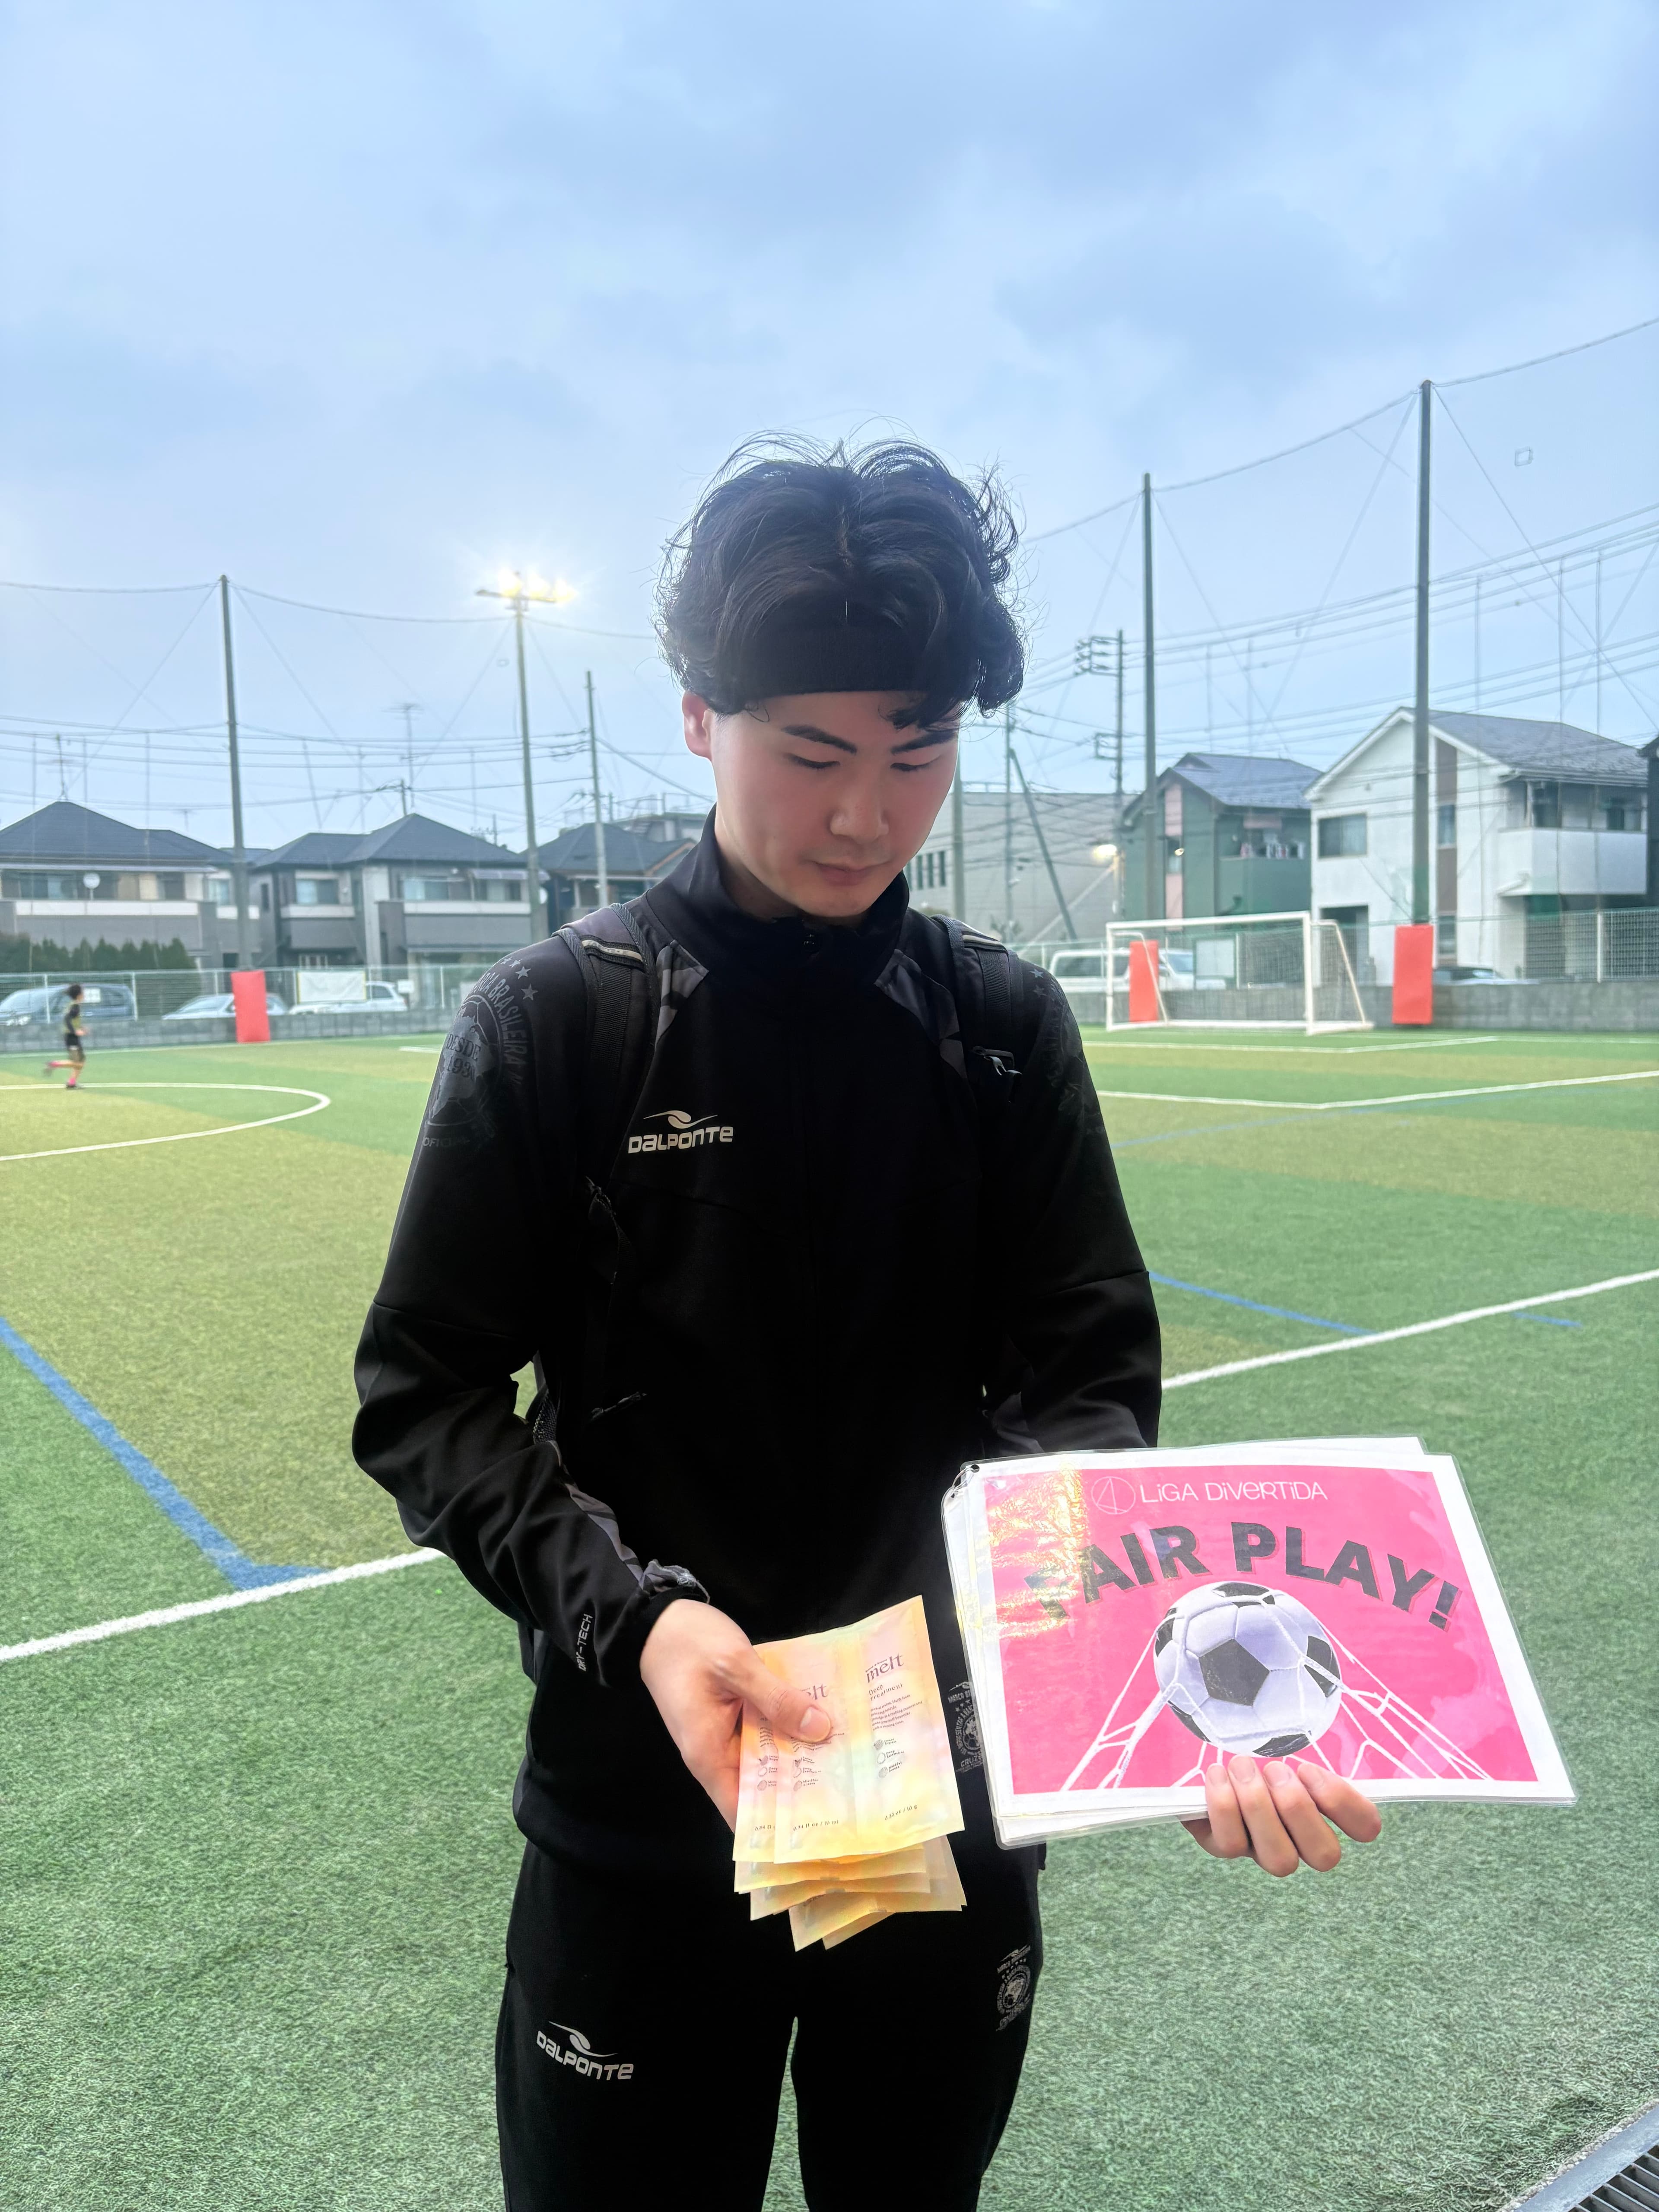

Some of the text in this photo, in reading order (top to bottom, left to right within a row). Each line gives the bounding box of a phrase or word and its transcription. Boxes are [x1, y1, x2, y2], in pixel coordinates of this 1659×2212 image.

[446, 1034, 480, 1061] DESDE
[1231, 1522, 1461, 1631] PLAY!
[576, 1614, 593, 1672] DRY-TECH
[867, 1653, 904, 1683] melt
